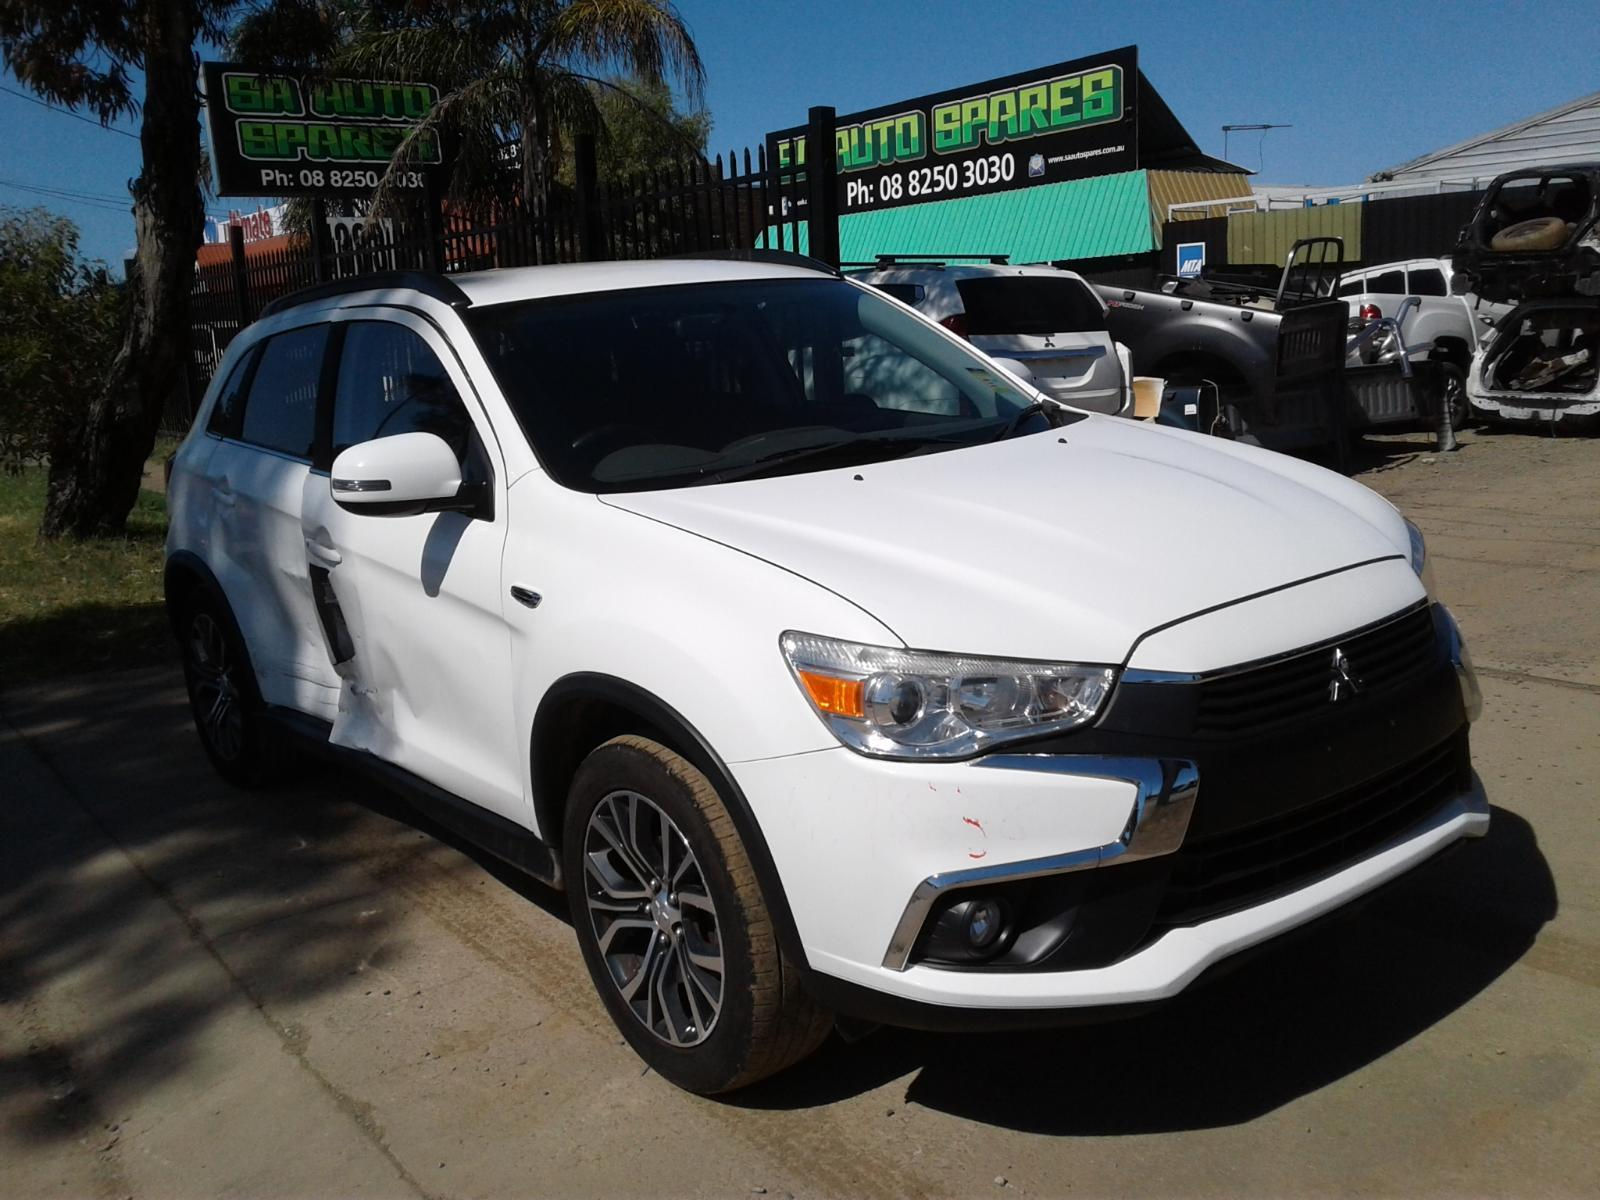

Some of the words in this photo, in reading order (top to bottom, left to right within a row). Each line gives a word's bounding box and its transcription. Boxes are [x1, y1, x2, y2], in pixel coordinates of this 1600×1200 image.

[225, 75, 301, 114] SA
[311, 78, 433, 118] AUTO
[836, 113, 924, 172] AUTO
[933, 67, 1118, 152] SPARES
[1047, 145, 1125, 164] www.saautospares.com.au
[260, 169, 294, 187] Ph:
[299, 170, 325, 187] 08
[330, 170, 377, 188] 8250
[385, 172, 425, 188] 030
[847, 179, 875, 206] Ph:
[880, 173, 903, 201] 08
[908, 163, 958, 196] 8250
[963, 153, 1015, 188] 3030
[1180, 259, 1202, 272] MTA
